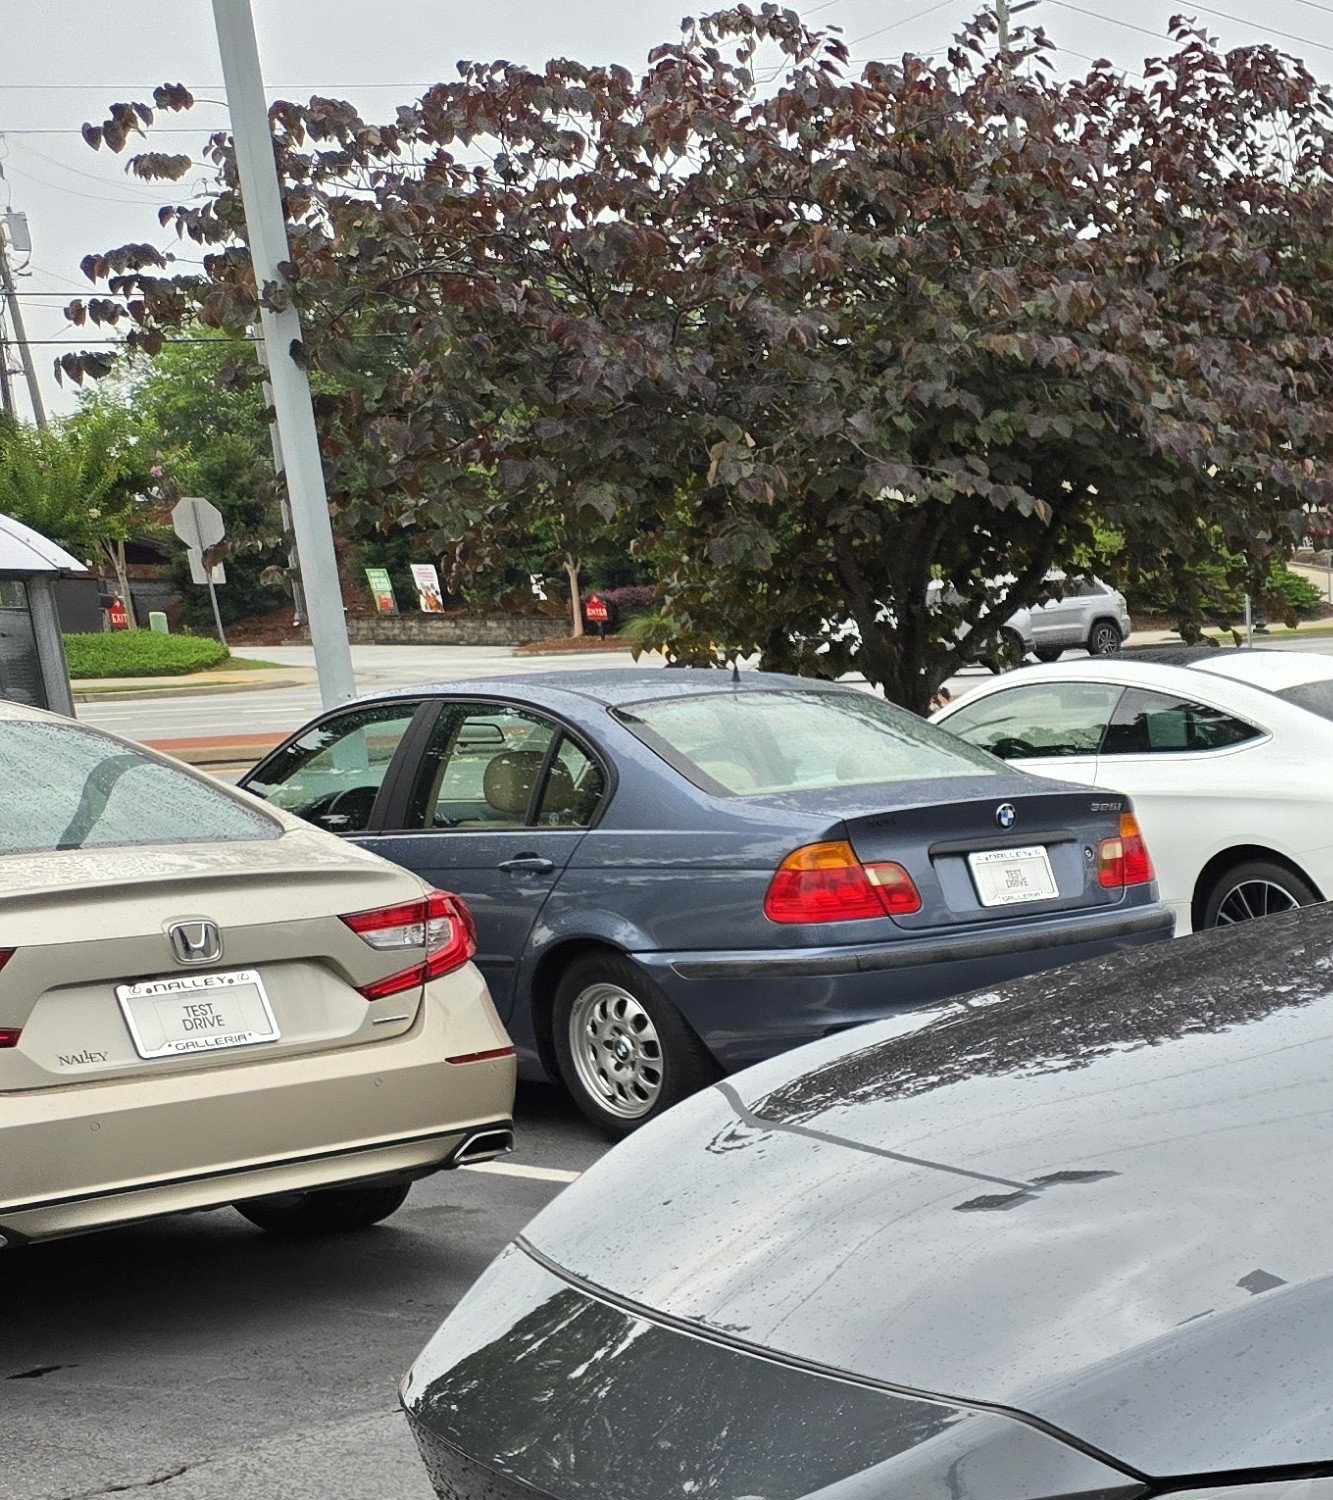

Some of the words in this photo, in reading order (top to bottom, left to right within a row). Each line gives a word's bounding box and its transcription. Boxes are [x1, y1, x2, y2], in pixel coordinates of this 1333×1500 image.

[1005, 869, 1022, 879] TEST
[1006, 878, 1029, 889] DRIVE
[153, 976, 227, 993] NALLEY
[182, 1002, 214, 1018] TEST
[182, 1015, 225, 1032] DRIVE
[175, 1034, 248, 1051] GALLERIA
[58, 1050, 108, 1066] NALLEY
